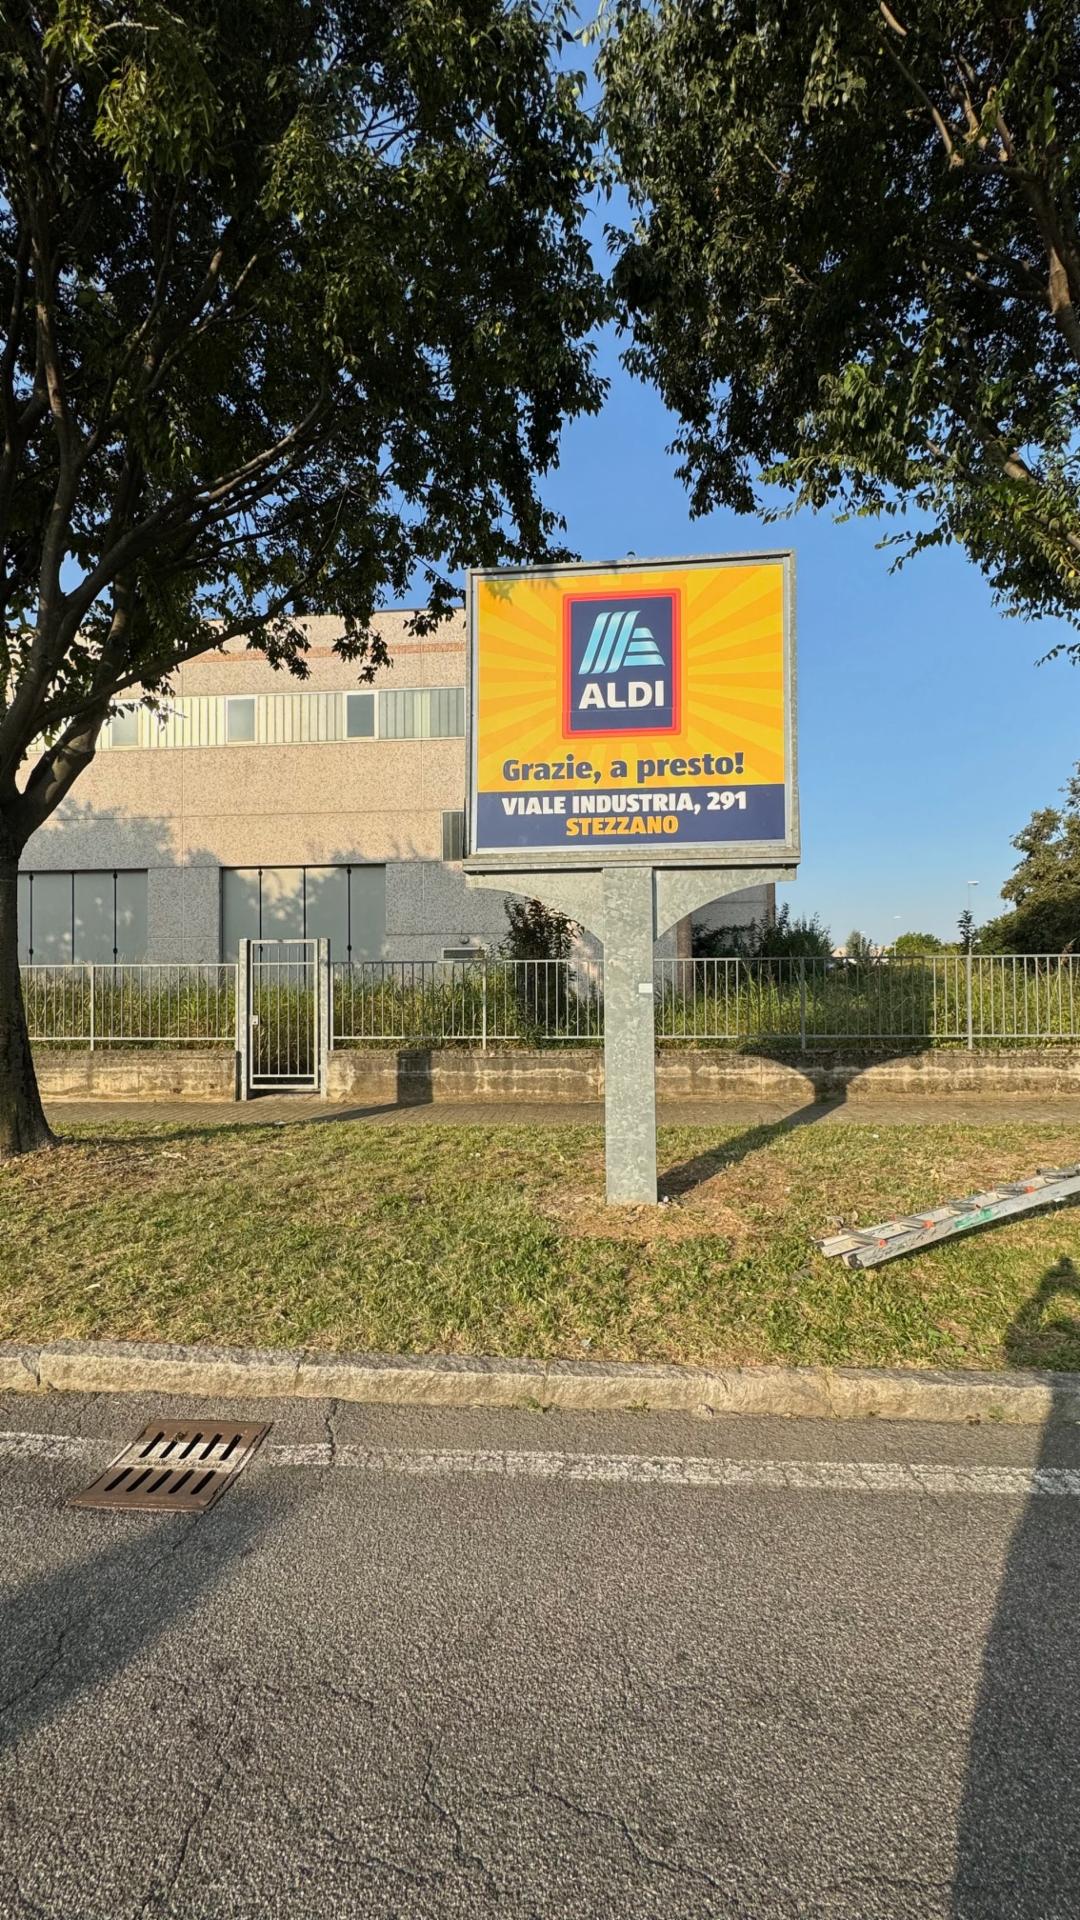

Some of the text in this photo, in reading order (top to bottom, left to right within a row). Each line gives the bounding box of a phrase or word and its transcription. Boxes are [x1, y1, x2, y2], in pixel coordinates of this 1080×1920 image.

[578, 680, 665, 709] ALDI
[502, 752, 744, 784] Grazie, a presto!
[502, 791, 747, 815] VIALE INDUSTRIA, 291
[565, 815, 679, 836] STEZZANO
